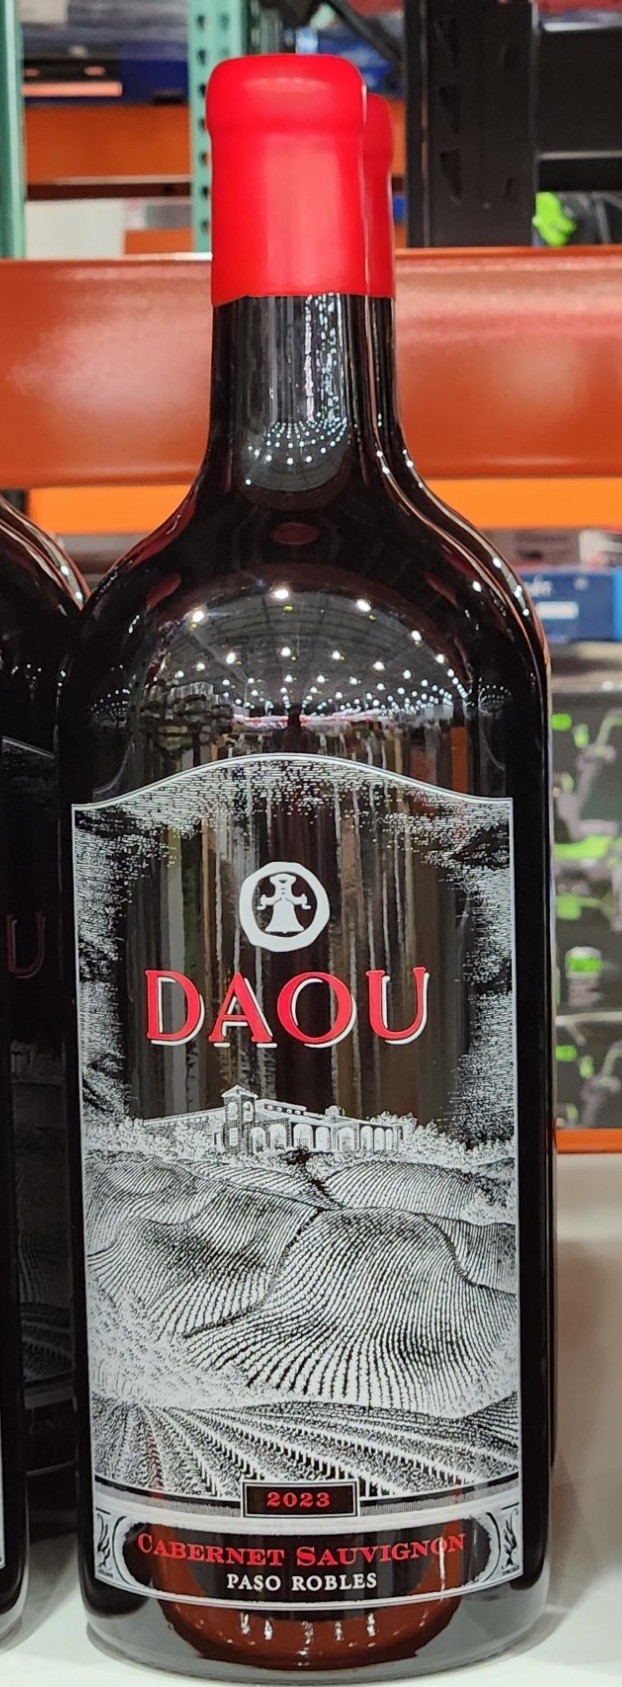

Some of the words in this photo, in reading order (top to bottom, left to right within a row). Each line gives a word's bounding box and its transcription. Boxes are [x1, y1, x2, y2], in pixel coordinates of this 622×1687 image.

[145, 966, 430, 1049] DAOU
[266, 1491, 331, 1508] 2023
[137, 1533, 285, 1566] CABERNET
[296, 1533, 466, 1567] SAUVIGNON
[226, 1573, 282, 1592] PASO
[291, 1572, 377, 1592] ROBLES
